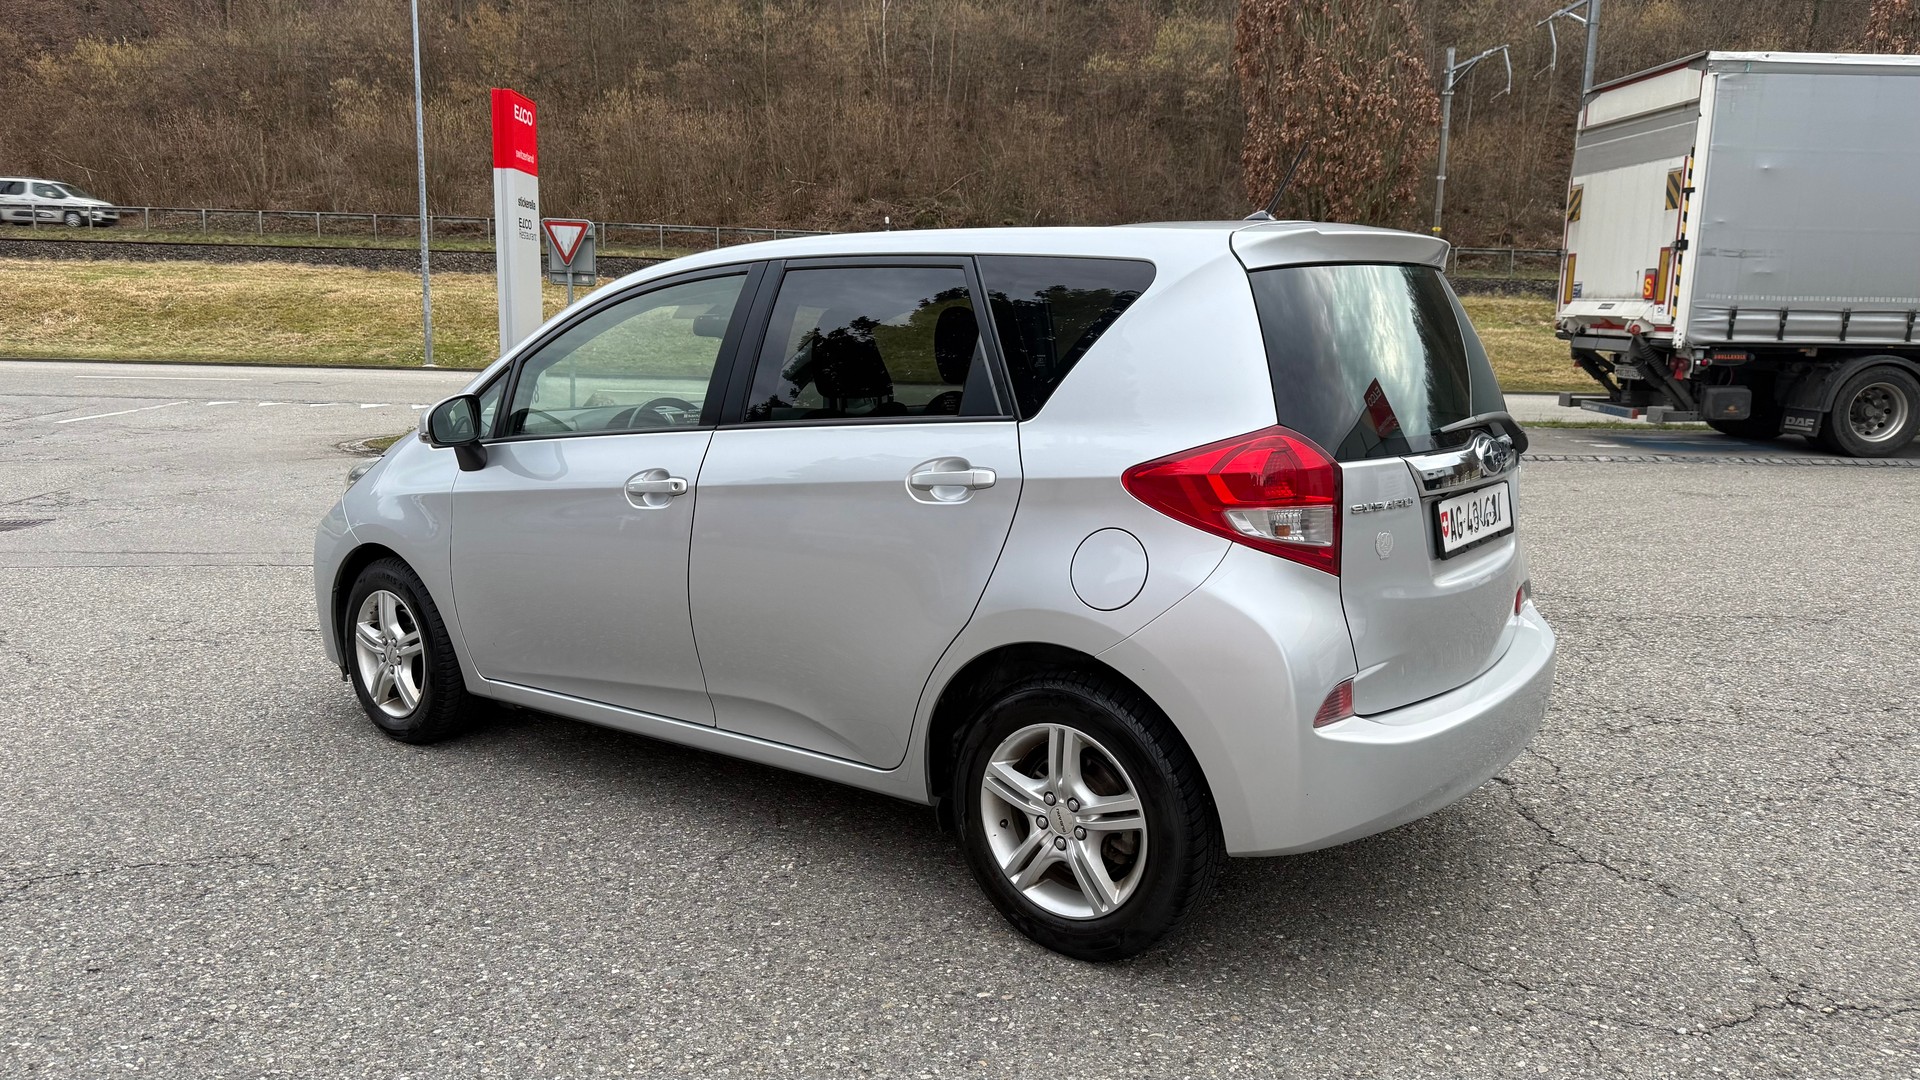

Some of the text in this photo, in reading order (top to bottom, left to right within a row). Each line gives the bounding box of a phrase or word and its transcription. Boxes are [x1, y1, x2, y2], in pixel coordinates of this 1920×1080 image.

[514, 104, 533, 126] ELCO
[518, 217, 532, 230] ELCO
[1644, 278, 1652, 296] S
[1785, 416, 1815, 427] DAF
[1350, 497, 1413, 514] SUBARU
